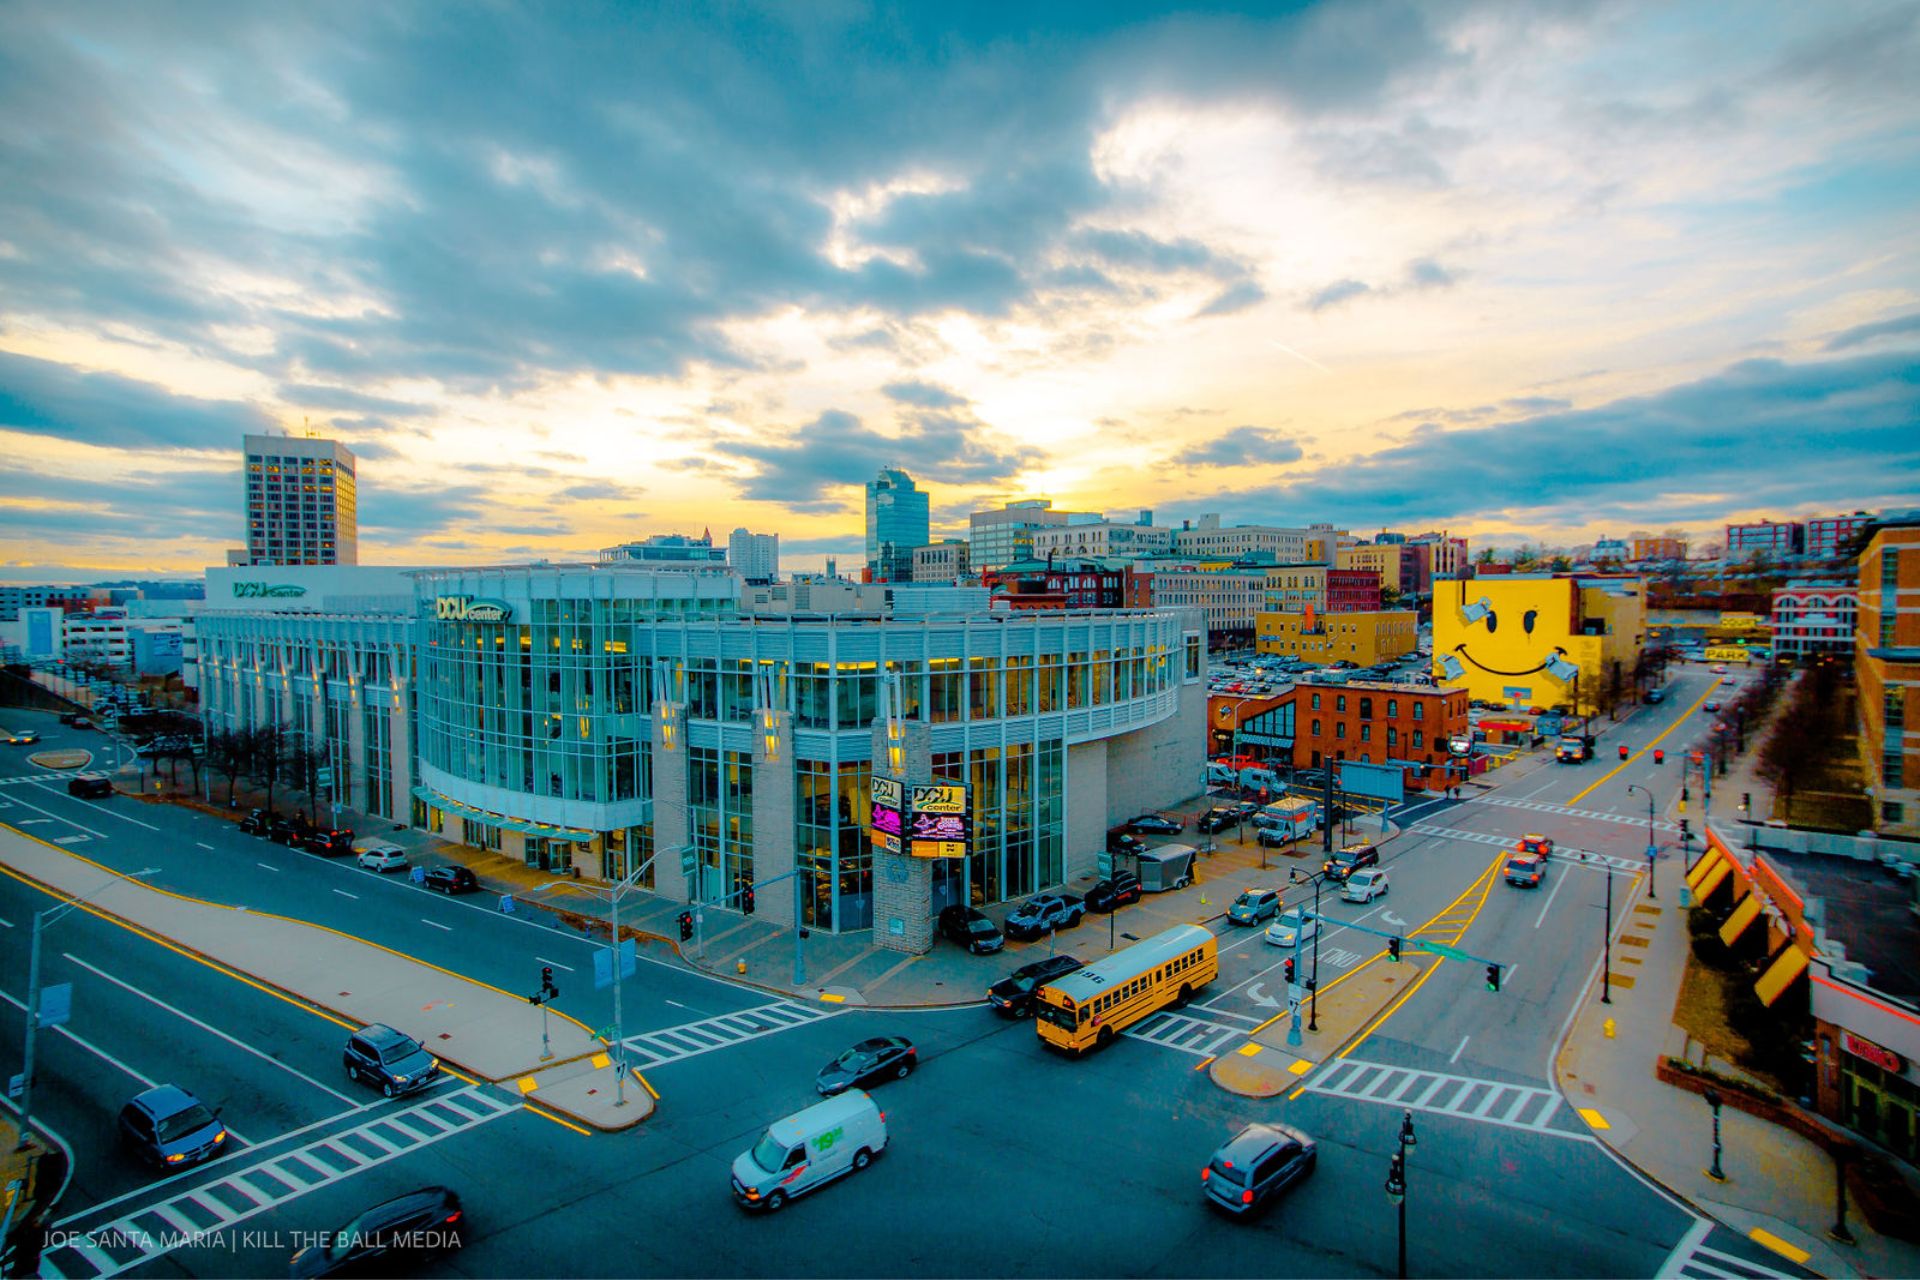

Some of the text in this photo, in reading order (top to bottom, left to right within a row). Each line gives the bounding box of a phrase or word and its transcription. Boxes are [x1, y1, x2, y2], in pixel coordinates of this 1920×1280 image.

[233, 582, 267, 598] DCU
[437, 597, 501, 621] DCU center
[1706, 649, 1748, 660] PARK
[914, 786, 953, 804] DCU
[927, 803, 961, 812] center
